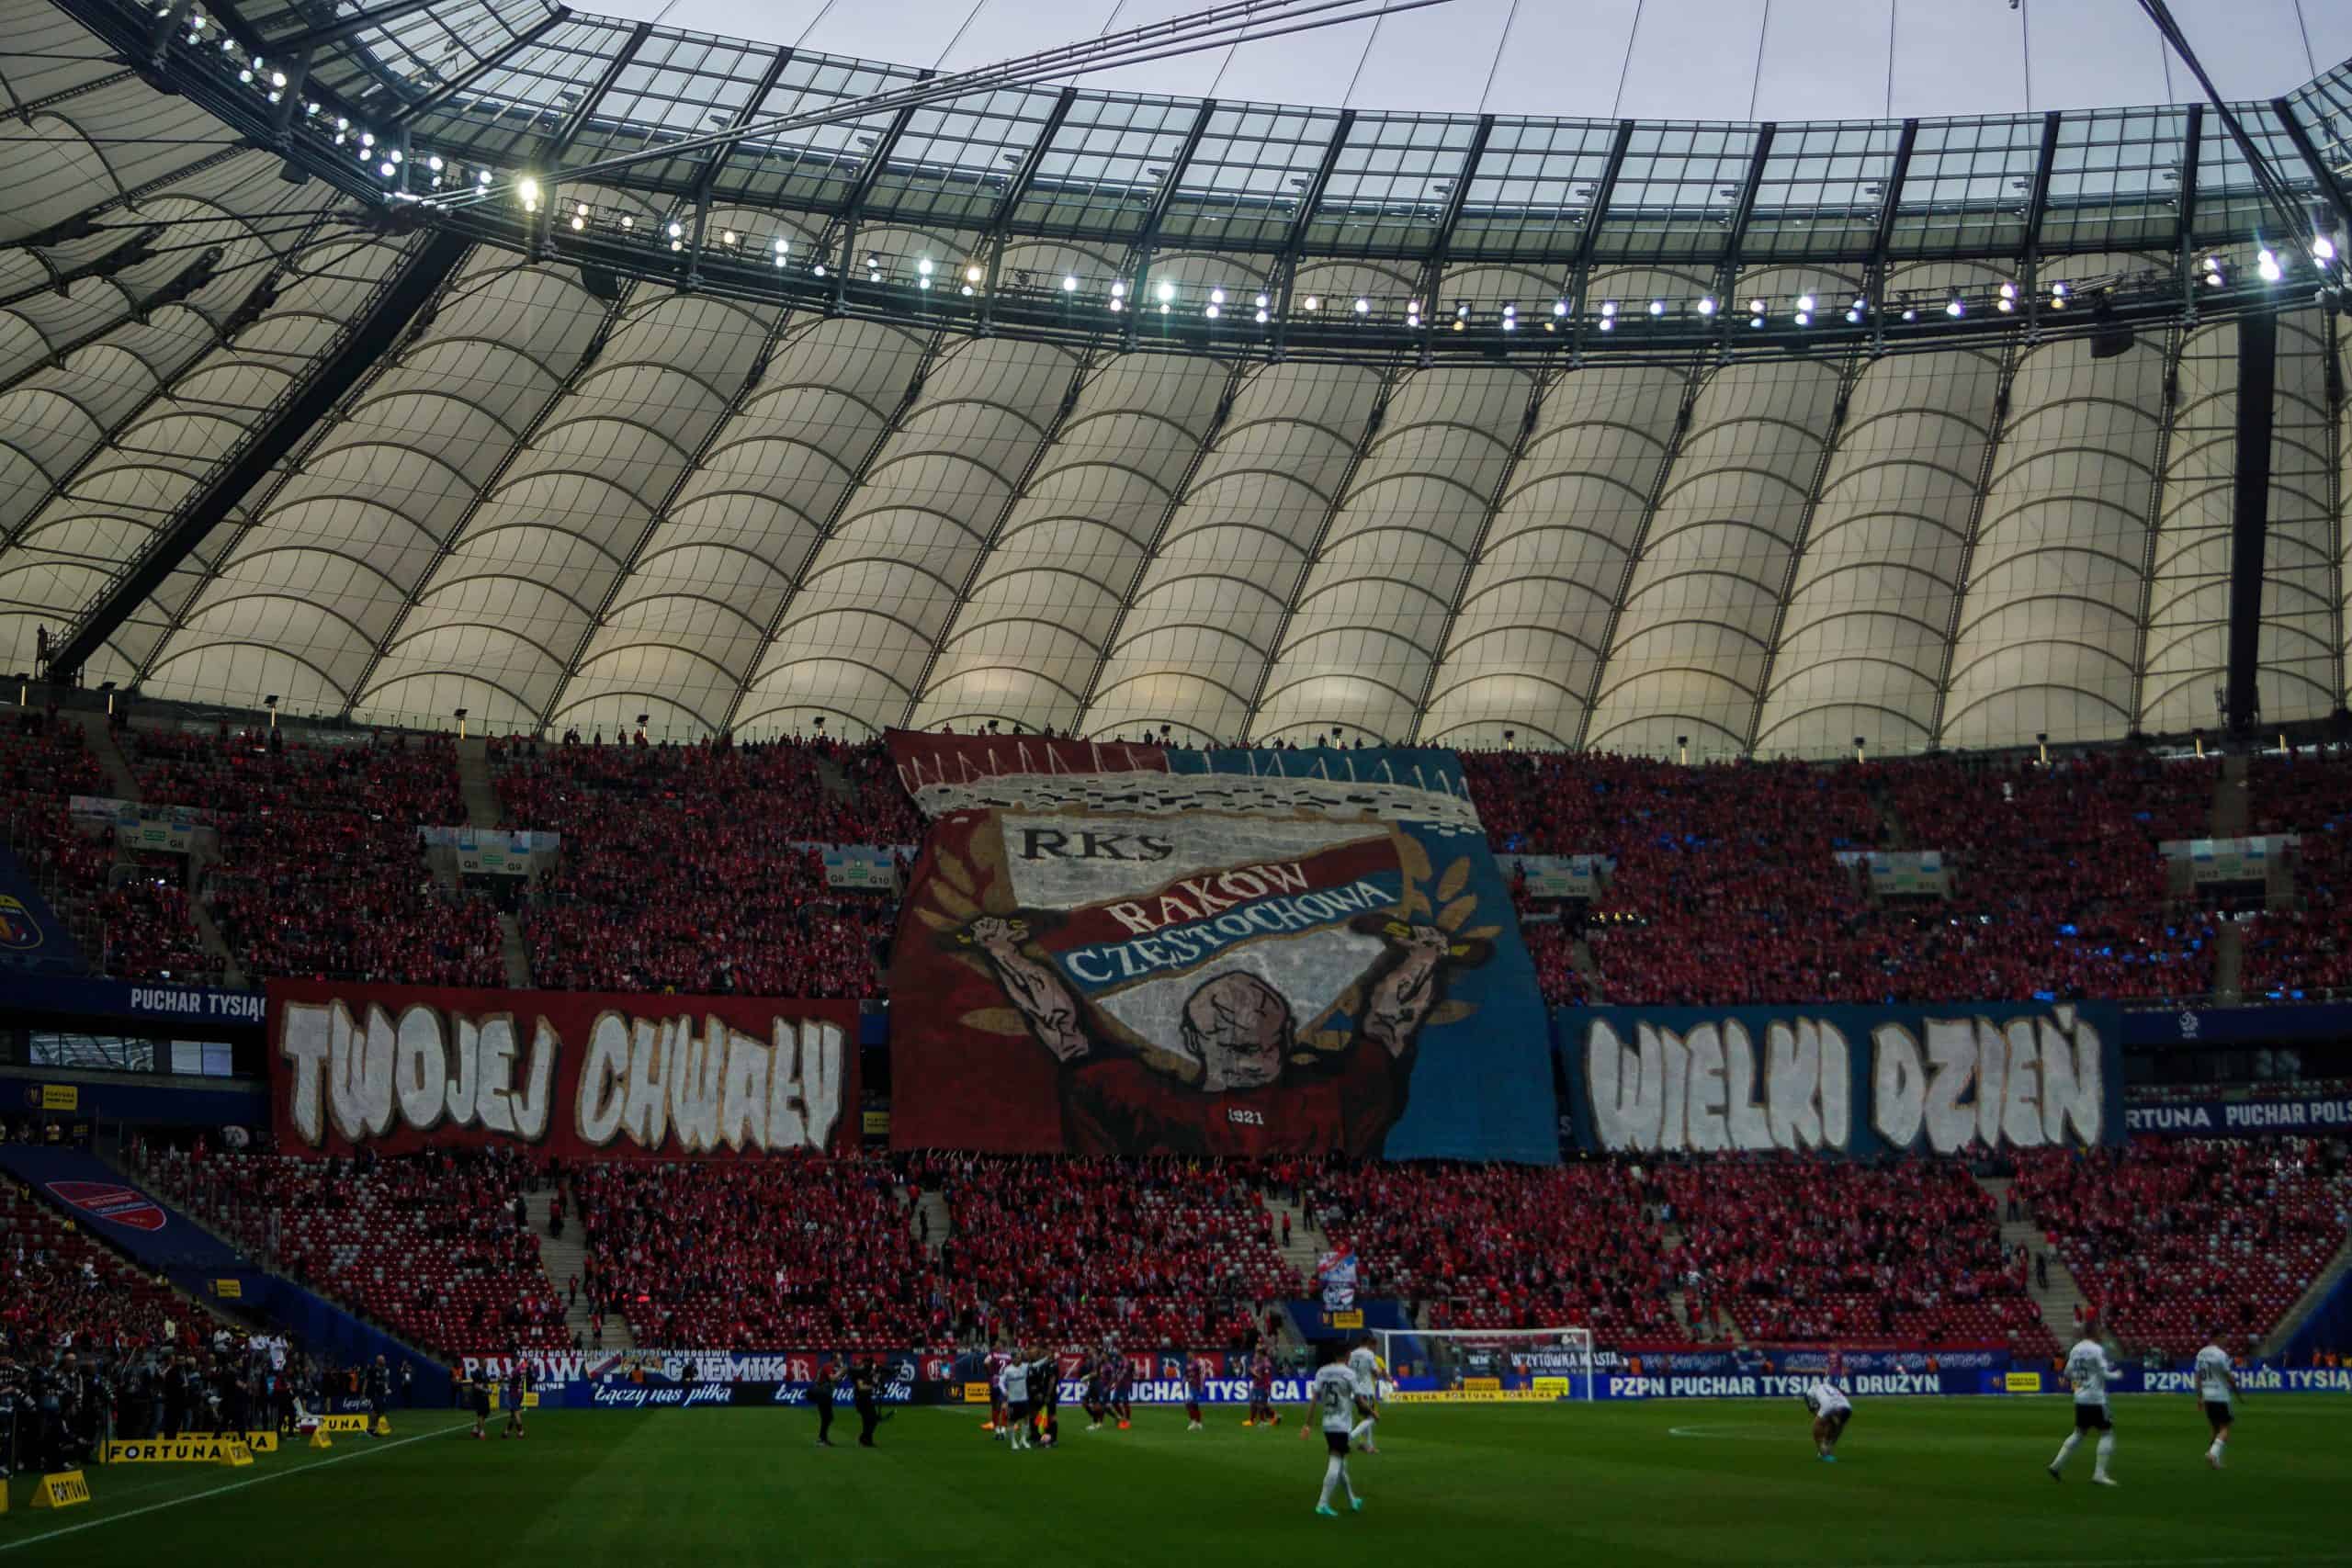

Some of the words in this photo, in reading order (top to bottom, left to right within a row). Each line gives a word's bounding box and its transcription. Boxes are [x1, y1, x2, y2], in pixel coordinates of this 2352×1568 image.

[1020, 828, 1174, 862] RKS
[130, 987, 201, 1013] PUCHAR
[280, 998, 560, 1147] TWOJEJ
[1587, 1017, 1851, 1153] WIELKI
[1227, 1107, 1264, 1125] 1921
[2224, 1102, 2307, 1127] PUCHAR
[1204, 1380, 1301, 1402] TYSCA
[1610, 1377, 1666, 1396] PZPN
[1670, 1376, 1757, 1395] PUCHAR
[2143, 1371, 2197, 1390] PZPN
[2230, 1370, 2282, 1389] CHAR
[594, 1383, 648, 1407] Łączy
[649, 1388, 684, 1402] nas
[684, 1383, 732, 1407] piłka
[109, 1445, 222, 1460] FORTUNA
